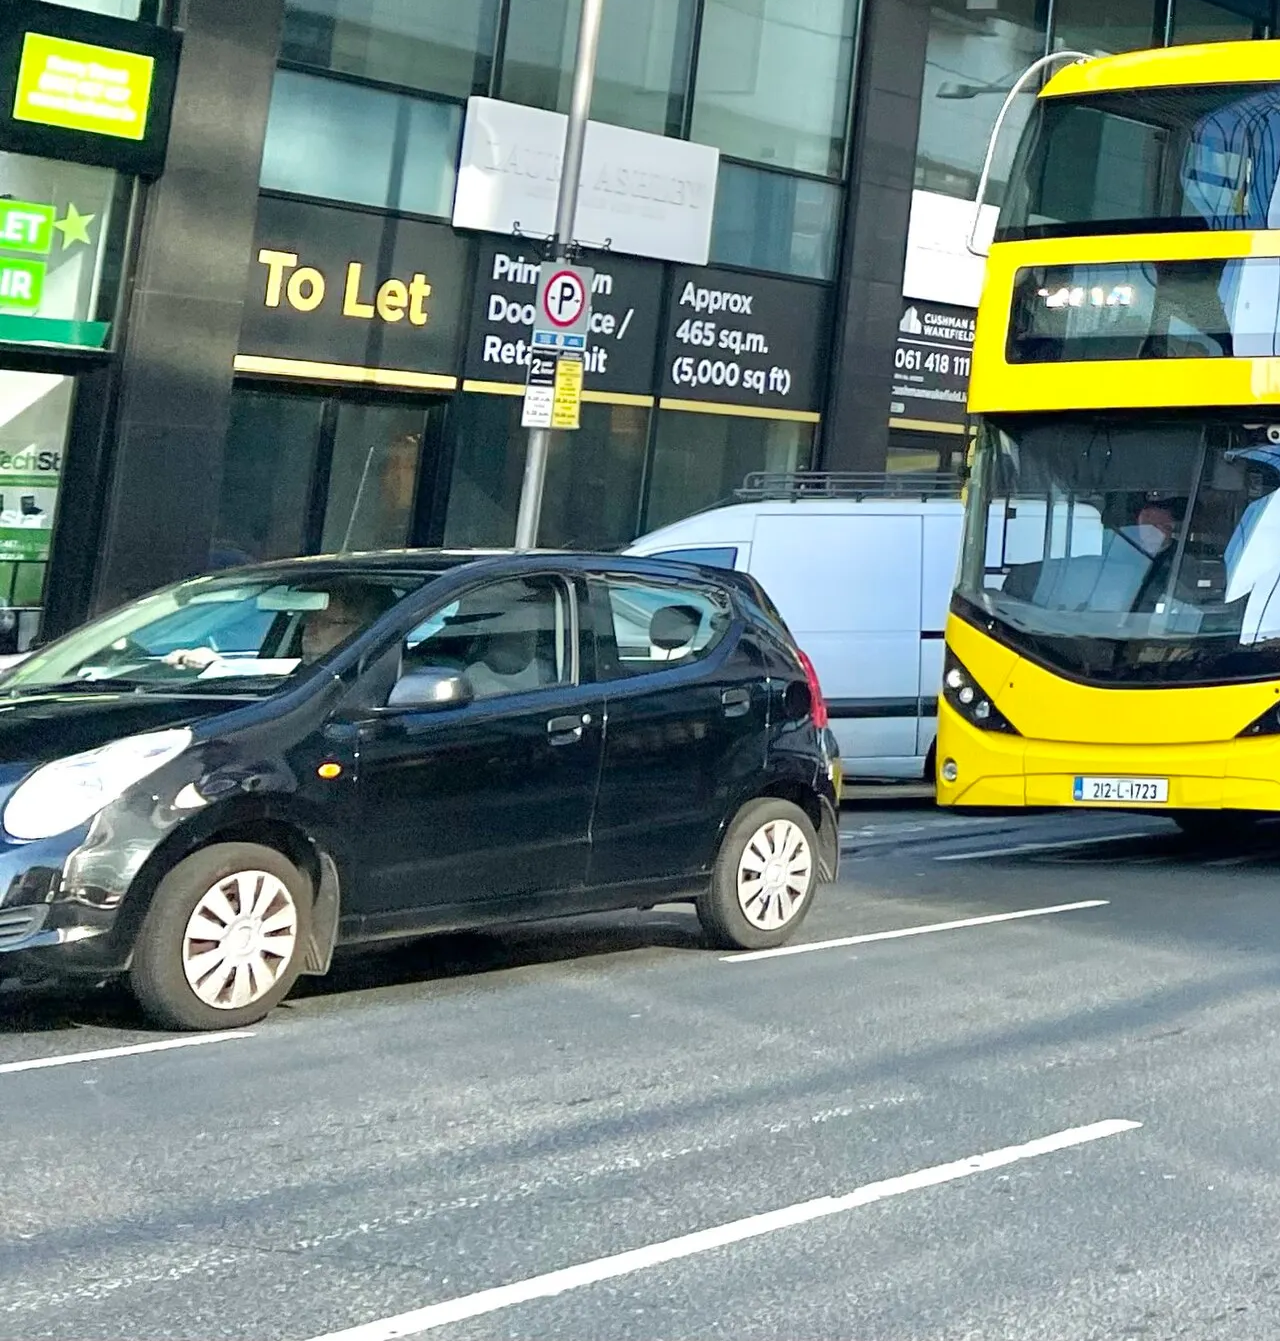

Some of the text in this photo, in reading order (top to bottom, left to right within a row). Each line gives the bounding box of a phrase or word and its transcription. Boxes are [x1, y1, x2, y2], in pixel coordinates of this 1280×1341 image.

[0, 211, 47, 243] ET
[493, 254, 541, 284] Prim
[258, 249, 432, 325] To Let
[558, 282, 575, 315] P
[680, 282, 752, 314] Approx
[488, 295, 536, 325] Doo
[924, 313, 968, 330] CUSHMAN
[675, 320, 768, 354] 465 sq.m.
[923, 325, 976, 342] WAKEFIELD
[483, 335, 532, 366] Reta
[584, 346, 608, 373] nit
[895, 348, 920, 370] 061
[924, 352, 949, 374] 418
[672, 357, 791, 395] (5,000 sq ft)
[1093, 782, 1157, 799] 212-L-1723
